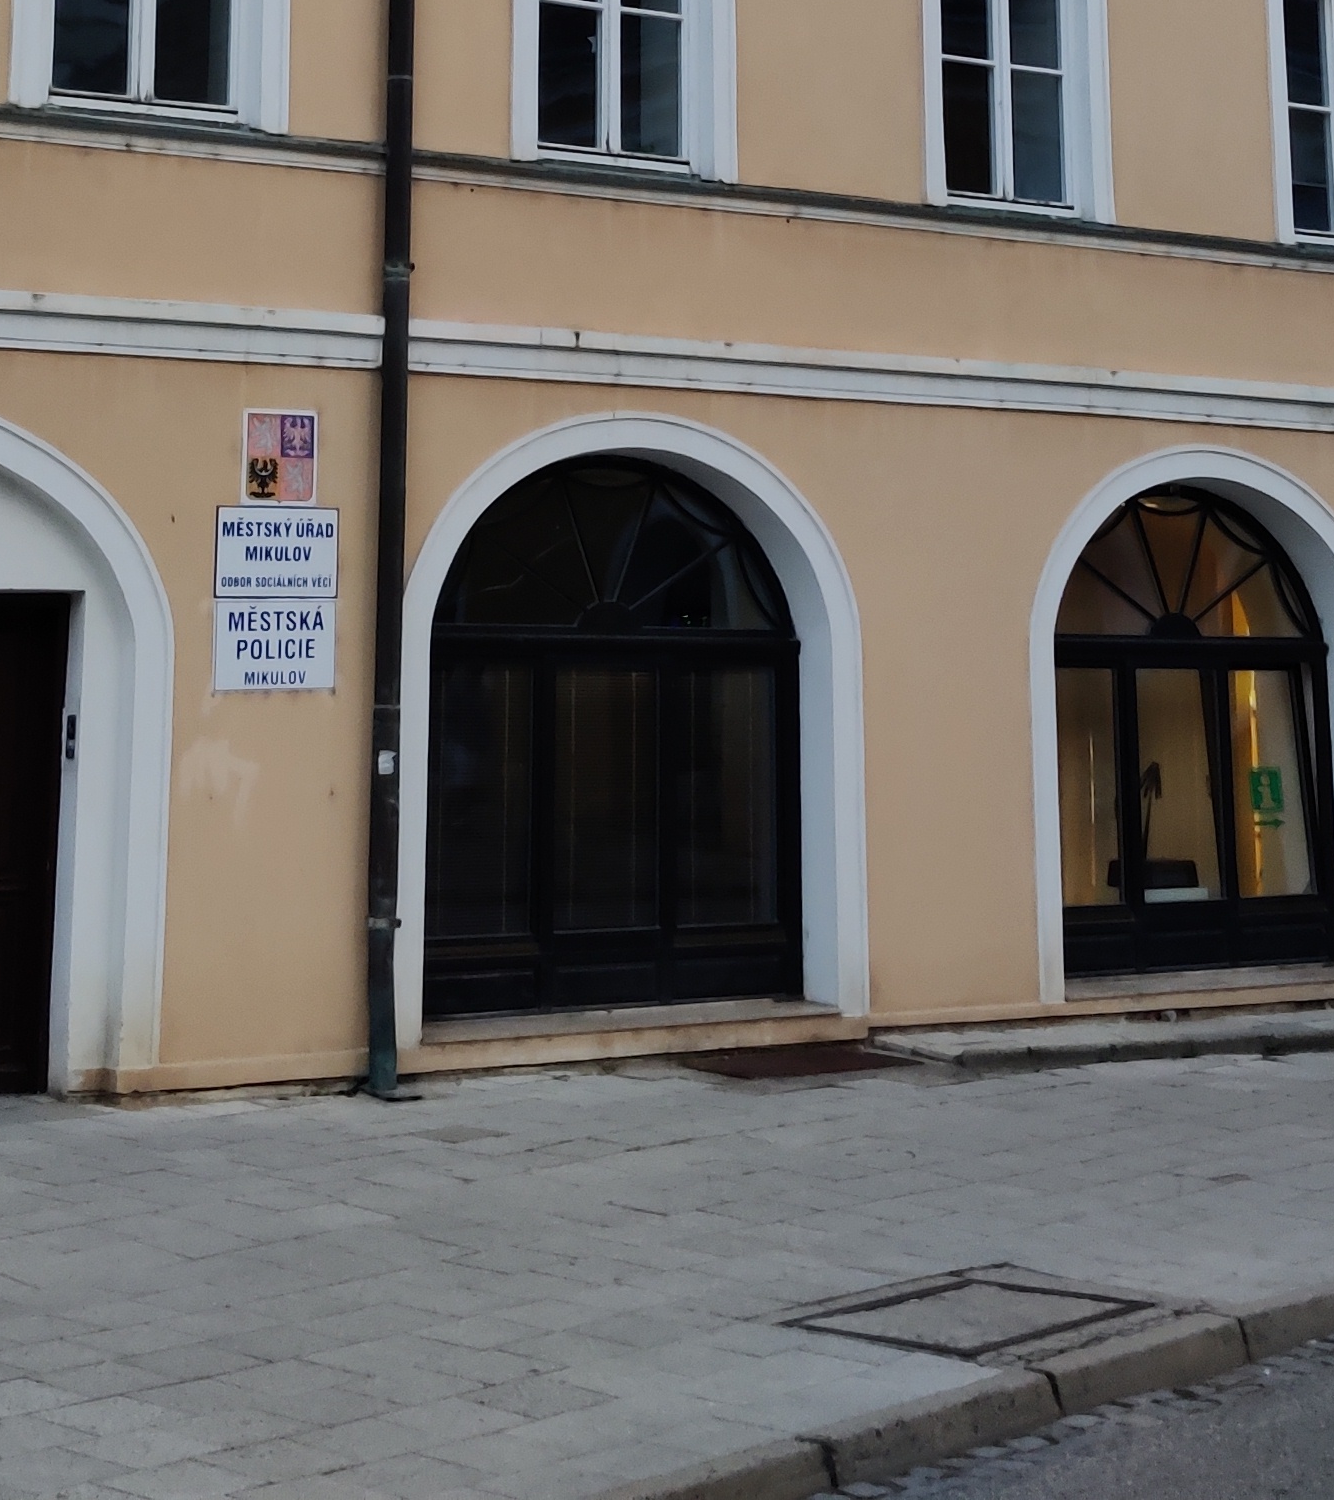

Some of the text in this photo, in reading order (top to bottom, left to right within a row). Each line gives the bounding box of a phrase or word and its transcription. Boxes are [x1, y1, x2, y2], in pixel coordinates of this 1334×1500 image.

[222, 517, 334, 538] MĚSTSKÝ ÚŘAD
[245, 546, 312, 561] MIKULOV
[221, 574, 332, 588] ODBOR SOCIÁLNÍCH VĚCÍ
[228, 605, 324, 632] MĚSTSKÁ
[236, 639, 315, 660] POLICIE
[244, 670, 306, 685] MIKULOV
